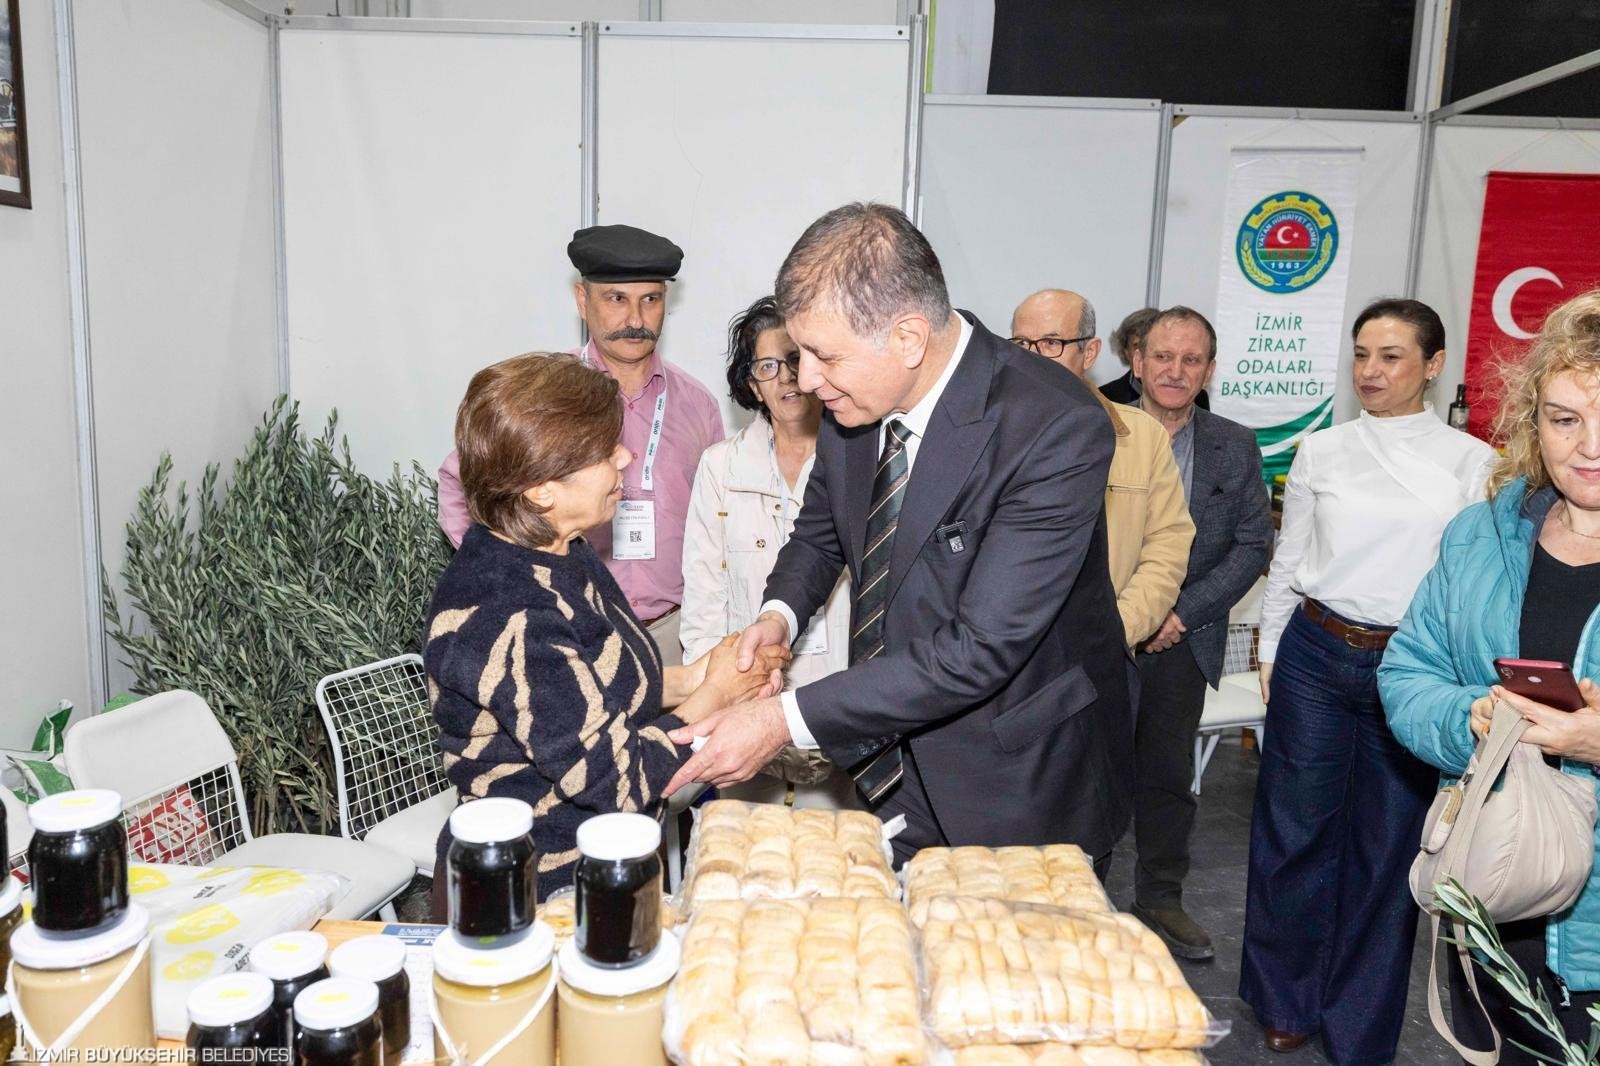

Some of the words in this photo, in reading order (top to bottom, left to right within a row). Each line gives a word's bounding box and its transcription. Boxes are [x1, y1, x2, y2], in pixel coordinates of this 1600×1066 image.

[1258, 223, 1272, 247] VATAN
[1255, 312, 1303, 331] İZMİR
[1247, 334, 1307, 352] ZİRAAT
[1237, 359, 1312, 374] ODALARI
[1221, 378, 1324, 399] BAŞKANLIĞI
